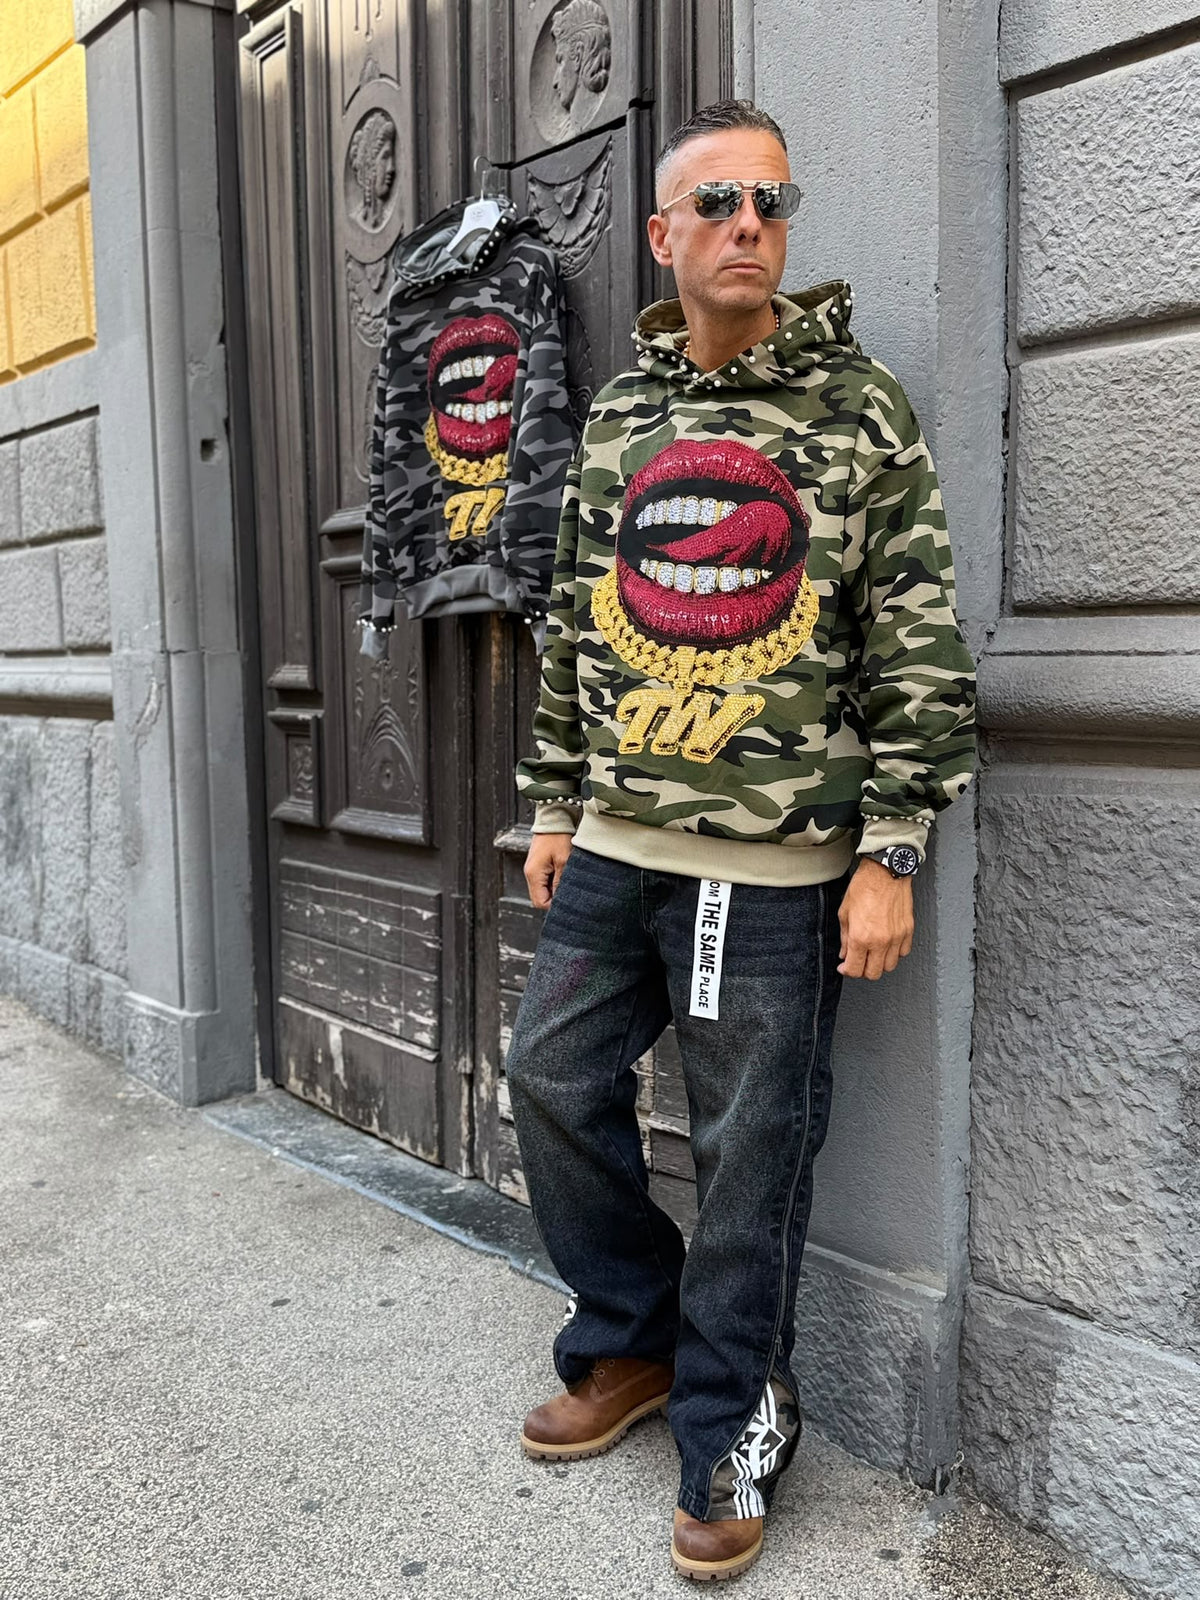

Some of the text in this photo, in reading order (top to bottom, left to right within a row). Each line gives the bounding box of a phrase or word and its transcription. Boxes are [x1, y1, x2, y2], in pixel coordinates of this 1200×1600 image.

[701, 901, 722, 930] THE
[699, 933, 717, 975] SAME
[698, 976, 710, 1009] PLACE
